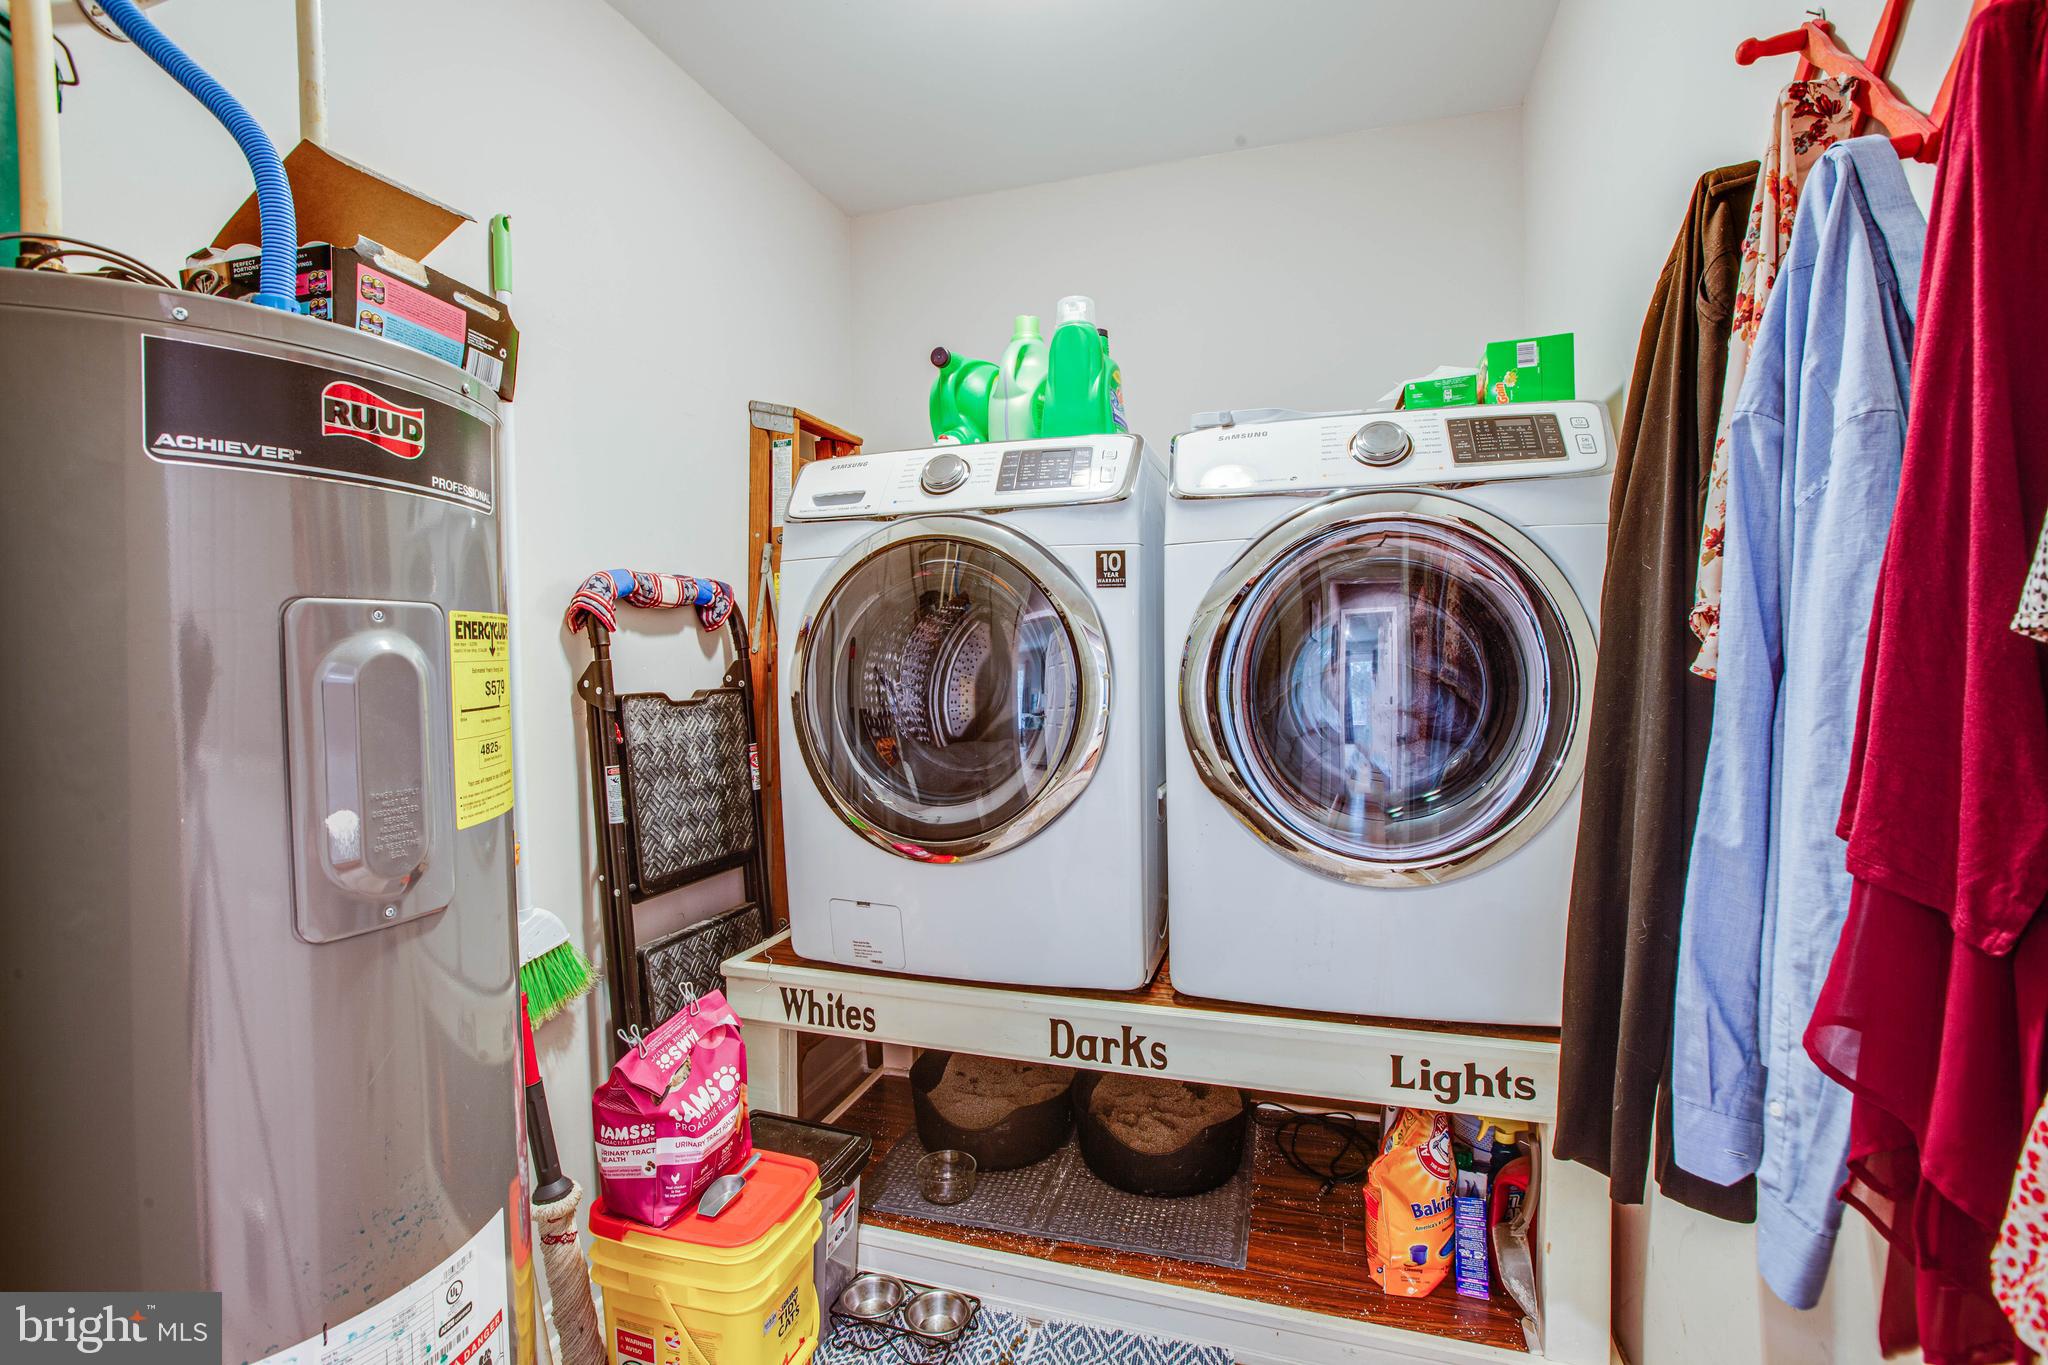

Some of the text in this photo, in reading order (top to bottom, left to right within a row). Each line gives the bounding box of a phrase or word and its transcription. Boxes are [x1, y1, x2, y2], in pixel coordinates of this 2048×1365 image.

[232, 260, 256, 269] PERFECT
[324, 400, 424, 443] RUUD
[1218, 431, 1268, 441] SAMSUNG
[154, 432, 296, 461] ACHIEVER
[830, 461, 868, 471] SAMSUNG
[431, 475, 491, 504] PROFESSIONAL
[1100, 553, 1121, 571] 10
[485, 680, 505, 696] $579
[480, 741, 499, 755] 4825
[779, 986, 876, 1033] Whites
[1049, 1018, 1168, 1071] Darks
[1389, 1054, 1536, 1105] Lights
[675, 1106, 718, 1132] PROACTIVE
[600, 1124, 640, 1141] IAMS
[601, 1137, 630, 1146] PROACTIVE
[675, 1139, 706, 1149] URINARY
[631, 1147, 656, 1156] TRACT
[779, 1294, 799, 1325] TIDY
[778, 1304, 800, 1337] CATS
[463, 1314, 501, 1361] DANGER
[625, 1336, 652, 1350] WARNING
[625, 1345, 642, 1355] AVISO
